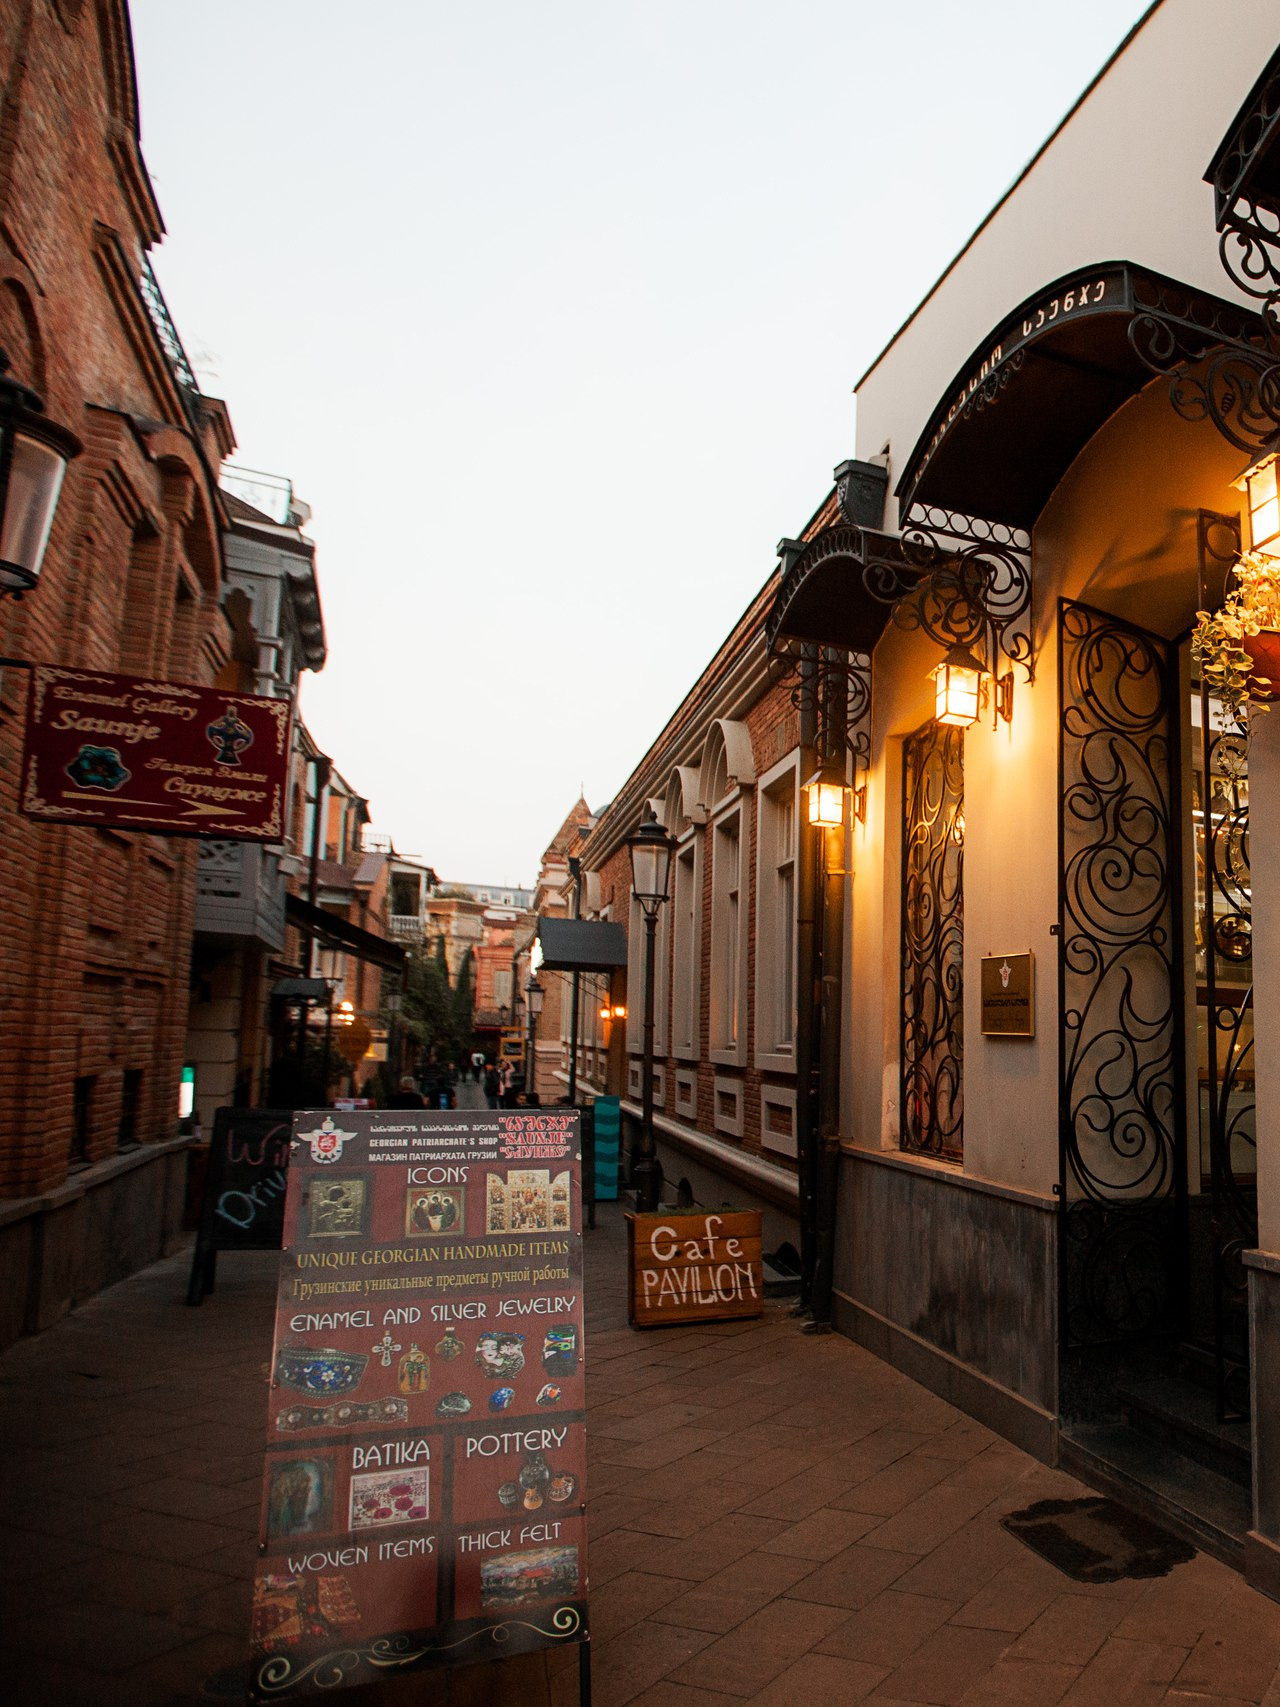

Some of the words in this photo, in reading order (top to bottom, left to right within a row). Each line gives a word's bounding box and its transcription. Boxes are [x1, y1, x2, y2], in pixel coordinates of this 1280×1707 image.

[1022, 280, 1106, 337] საუნჯე
[53, 686, 132, 707] Enamel
[132, 697, 198, 721] Gallery
[50, 709, 162, 744] Saunje
[368, 1153, 407, 1162] МАГАЗИН
[409, 1151, 466, 1161] ПАТРИАРХАТА
[467, 1151, 498, 1160] ГРУЗИИ
[369, 1138, 408, 1147] GEORGIAN
[412, 1137, 475, 1146] PATRIARCHATE'S
[478, 1137, 498, 1146] SHOP
[407, 1166, 470, 1184] ICONS
[296, 1250, 358, 1269] UNIQUE
[361, 1246, 440, 1266] GEORGIAN
[443, 1242, 525, 1261] HANDMADE
[528, 1240, 569, 1256] ITEMS
[650, 1215, 744, 1261] Cafe
[293, 1278, 362, 1300] Грузинские
[364, 1274, 433, 1297] уникальные
[436, 1270, 489, 1291] предметы
[491, 1266, 530, 1288] ручной
[532, 1264, 570, 1286] работы
[642, 1261, 758, 1308] PAVILION
[289, 1310, 374, 1332] ENAMEL
[382, 1307, 422, 1326] AND
[431, 1302, 487, 1323] SILVER
[495, 1295, 577, 1318] JEWELRY
[352, 1439, 430, 1469] BATIKA
[466, 1427, 568, 1458] POTTERY
[288, 1546, 368, 1573] WOVEN
[378, 1536, 436, 1561] ITEMS
[457, 1529, 511, 1553] THICK
[519, 1522, 562, 1543] FELT
